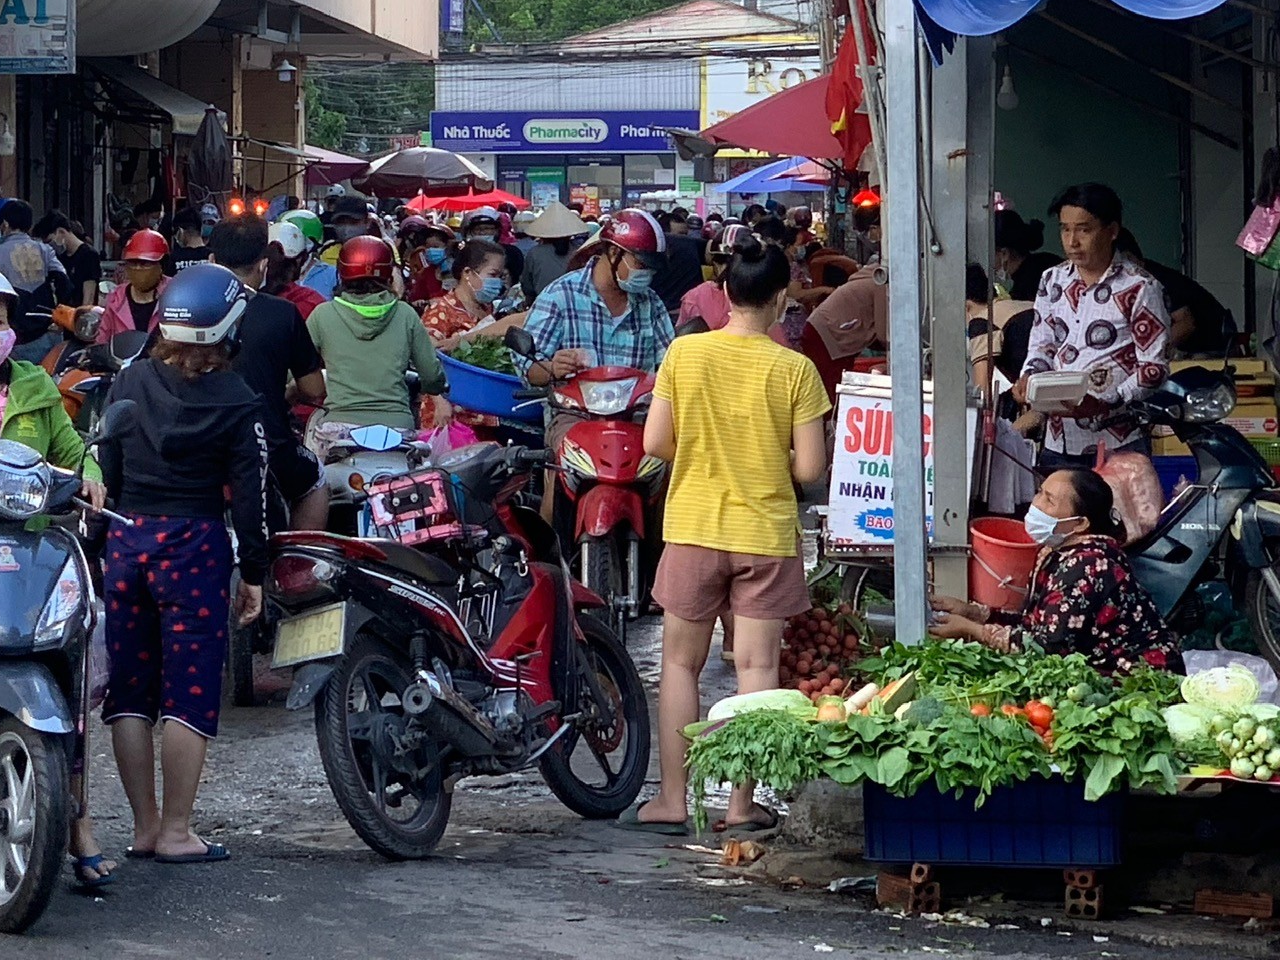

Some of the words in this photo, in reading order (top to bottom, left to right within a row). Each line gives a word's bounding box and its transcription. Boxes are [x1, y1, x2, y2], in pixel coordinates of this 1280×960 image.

[443, 124, 470, 139] Nhà
[472, 121, 511, 139] Thuốc
[529, 122, 601, 140] Pharmacity
[858, 459, 894, 478] TOÀ
[839, 481, 886, 502] NHẬN
